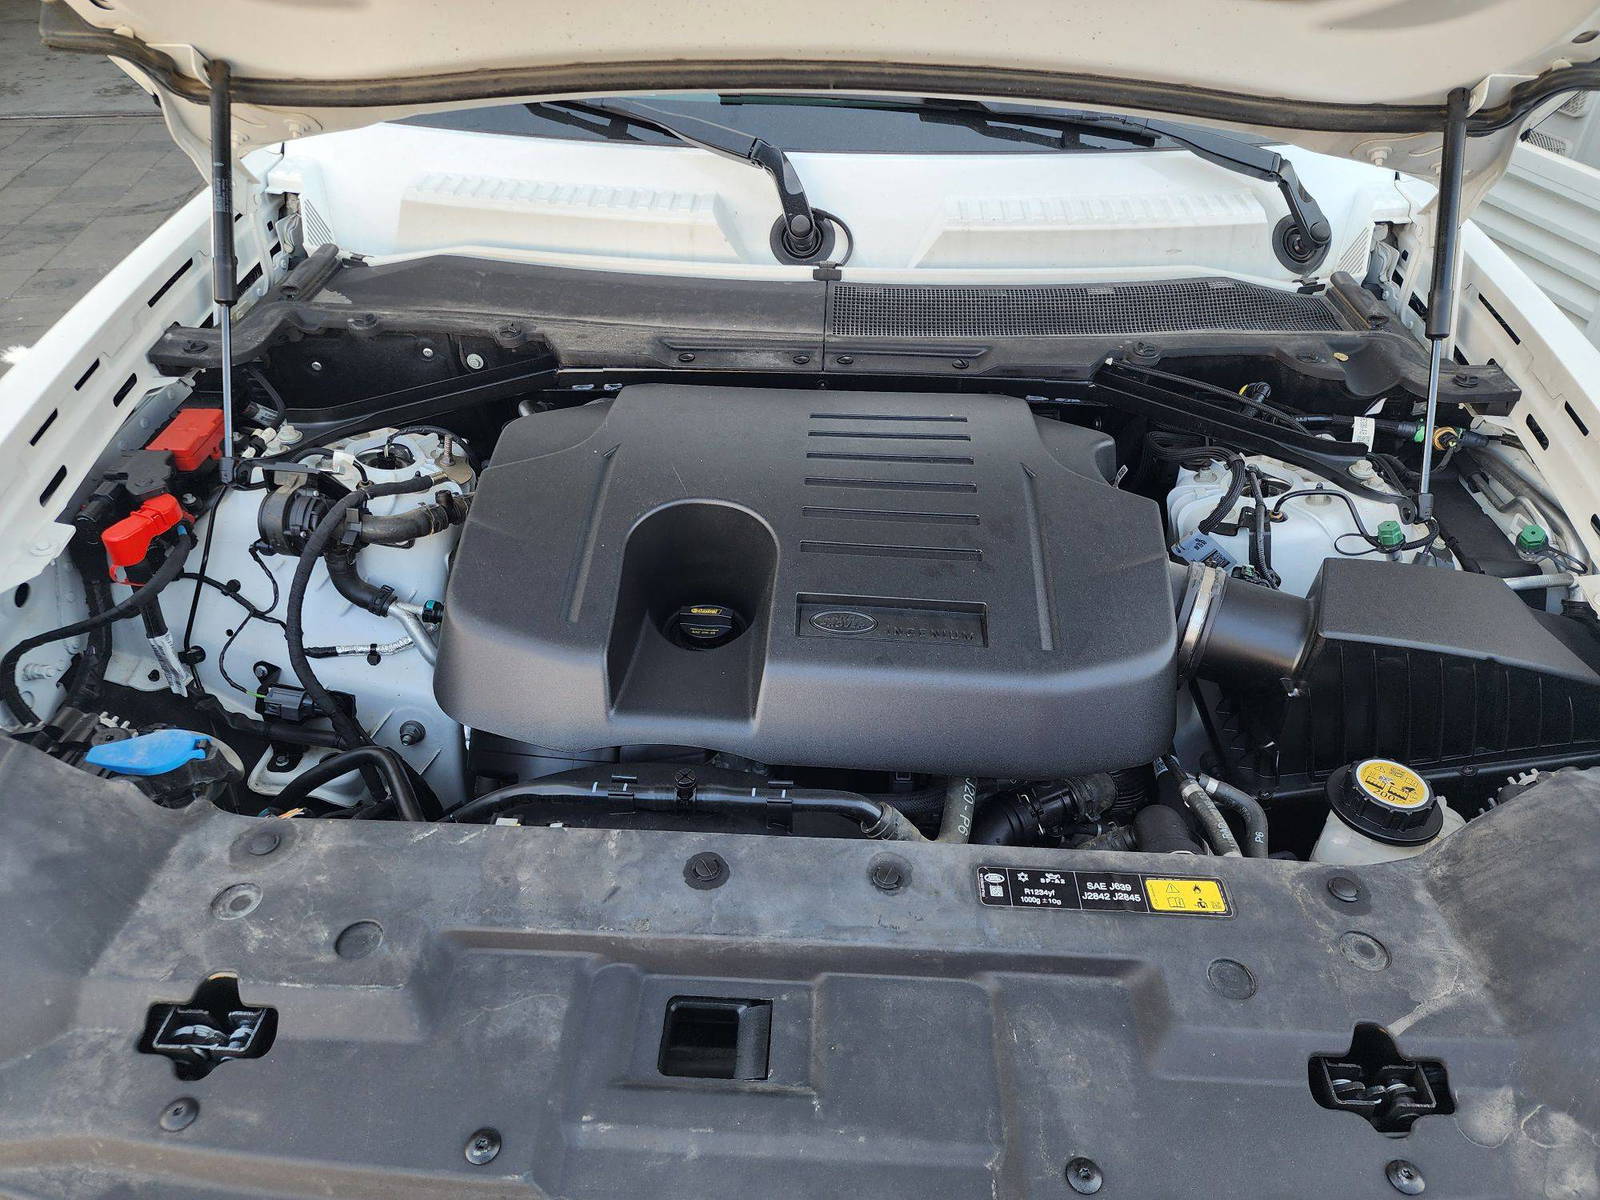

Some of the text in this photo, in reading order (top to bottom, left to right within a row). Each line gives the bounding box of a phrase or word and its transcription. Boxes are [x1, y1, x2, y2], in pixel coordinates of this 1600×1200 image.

[1086, 882, 1132, 891] SAE J639
[1024, 888, 1055, 897] R1234yf
[1082, 892, 1142, 902] J2842 J2845
[1020, 896, 1041, 904] 1000g
